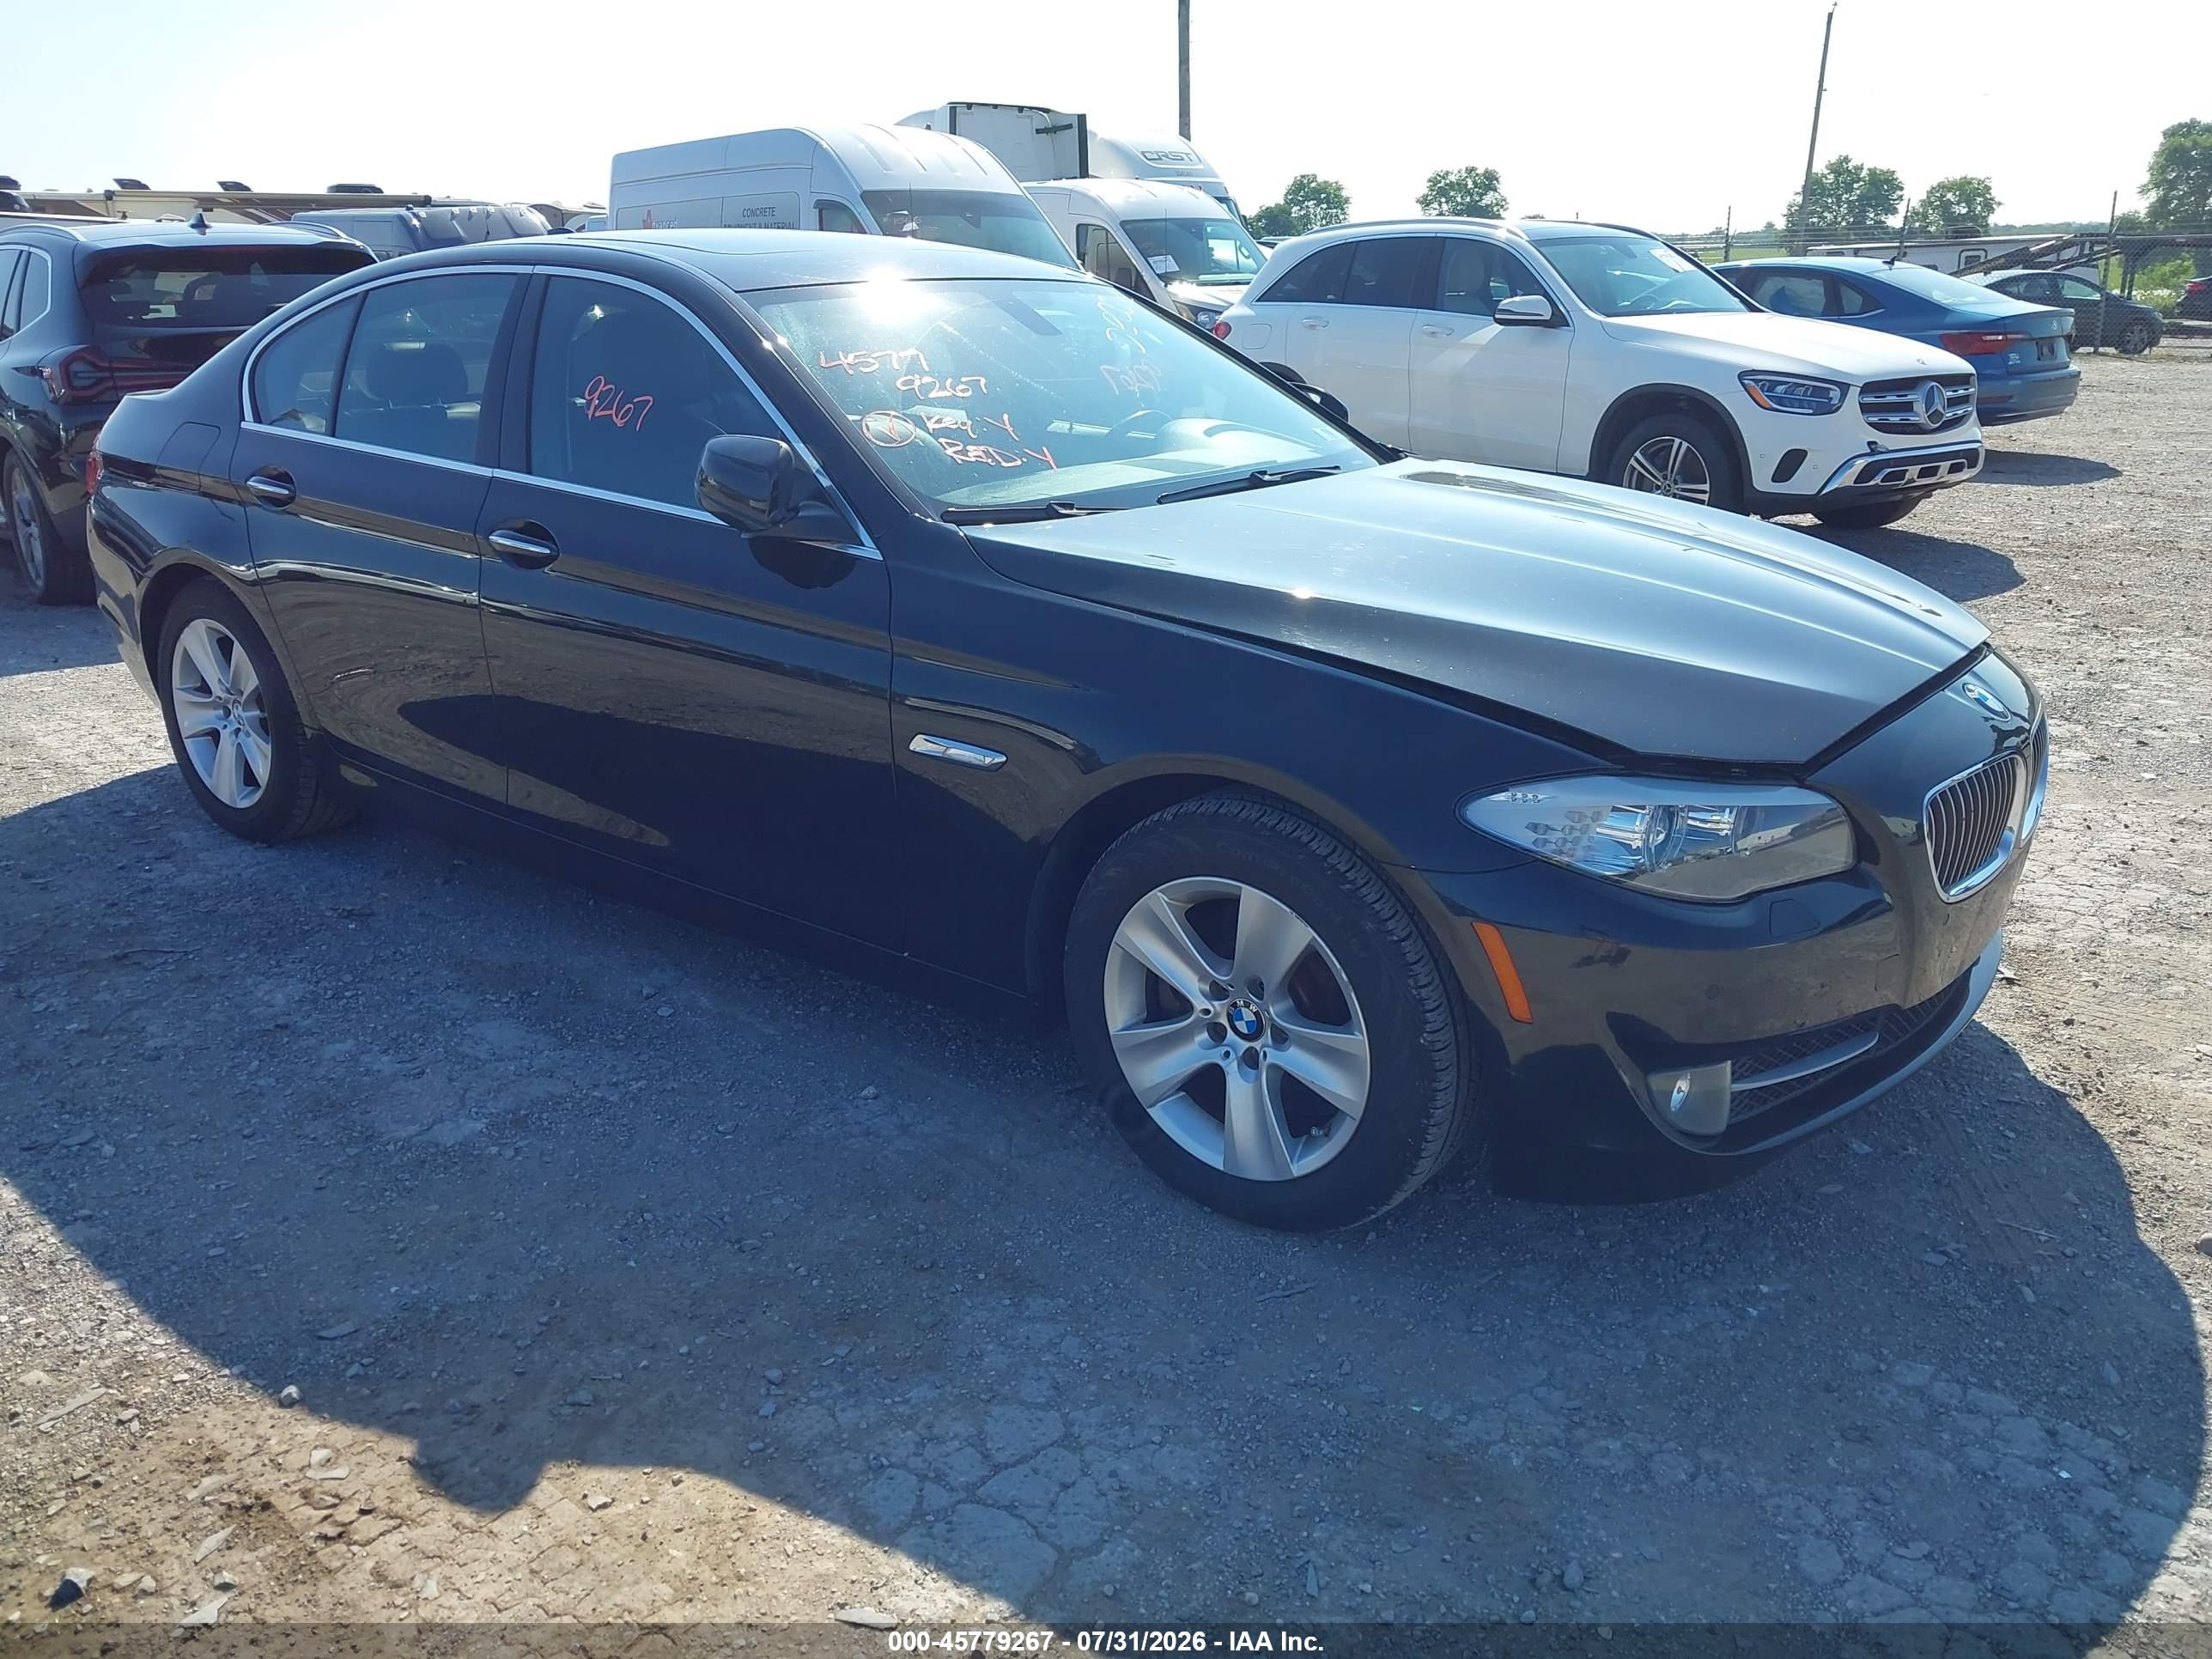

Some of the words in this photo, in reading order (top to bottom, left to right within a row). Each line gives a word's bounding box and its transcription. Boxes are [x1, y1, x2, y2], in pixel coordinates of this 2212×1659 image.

[1139, 150, 1194, 162] CRST
[742, 206, 776, 218] CONCRETE
[818, 347, 930, 375] 4577
[896, 373, 988, 399] 9267
[584, 374, 653, 432] 9267
[1229, 1000, 1258, 1014] BMW
